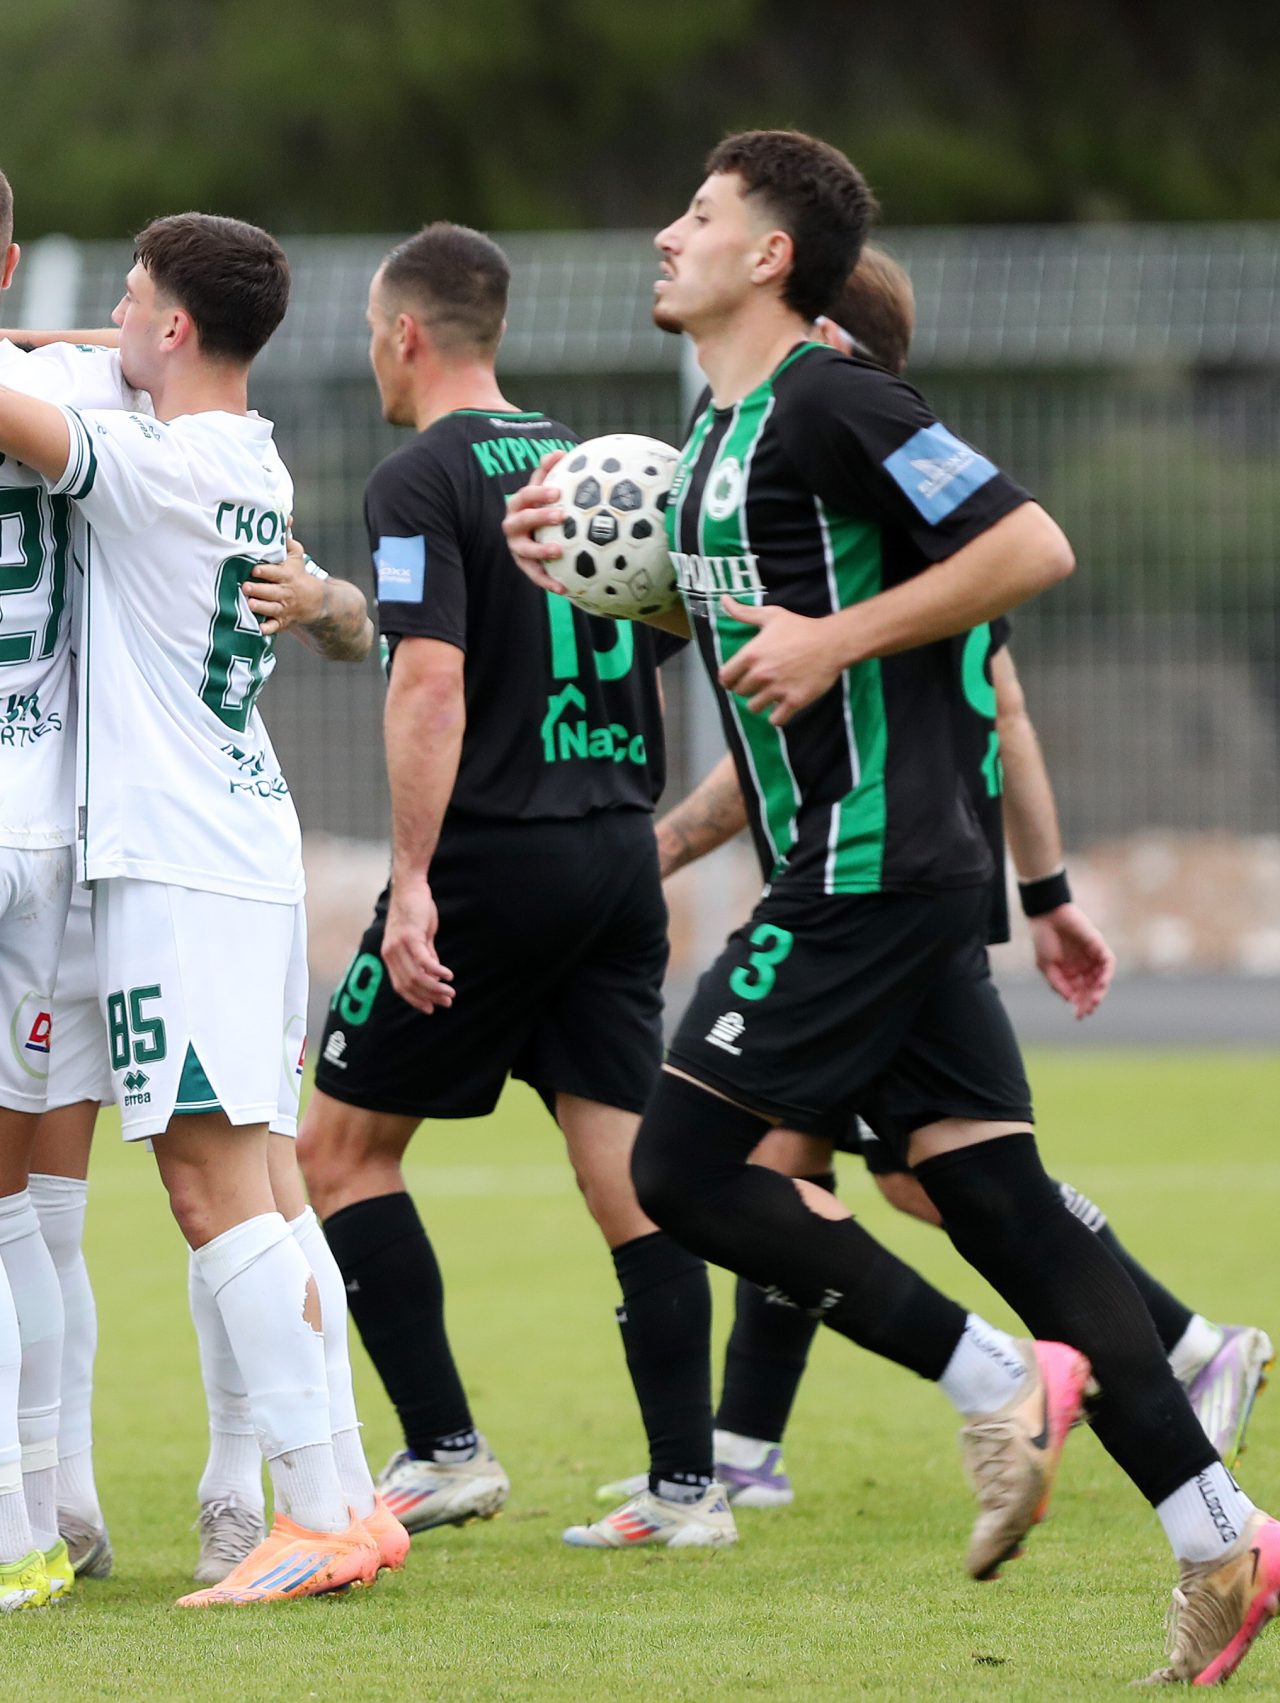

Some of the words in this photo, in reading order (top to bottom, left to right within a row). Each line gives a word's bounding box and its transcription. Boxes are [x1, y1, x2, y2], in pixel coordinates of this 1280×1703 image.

[197, 554, 277, 734] 8
[729, 923, 794, 1001] 3
[107, 983, 167, 1071] 85
[124, 1092, 151, 1107] errea
